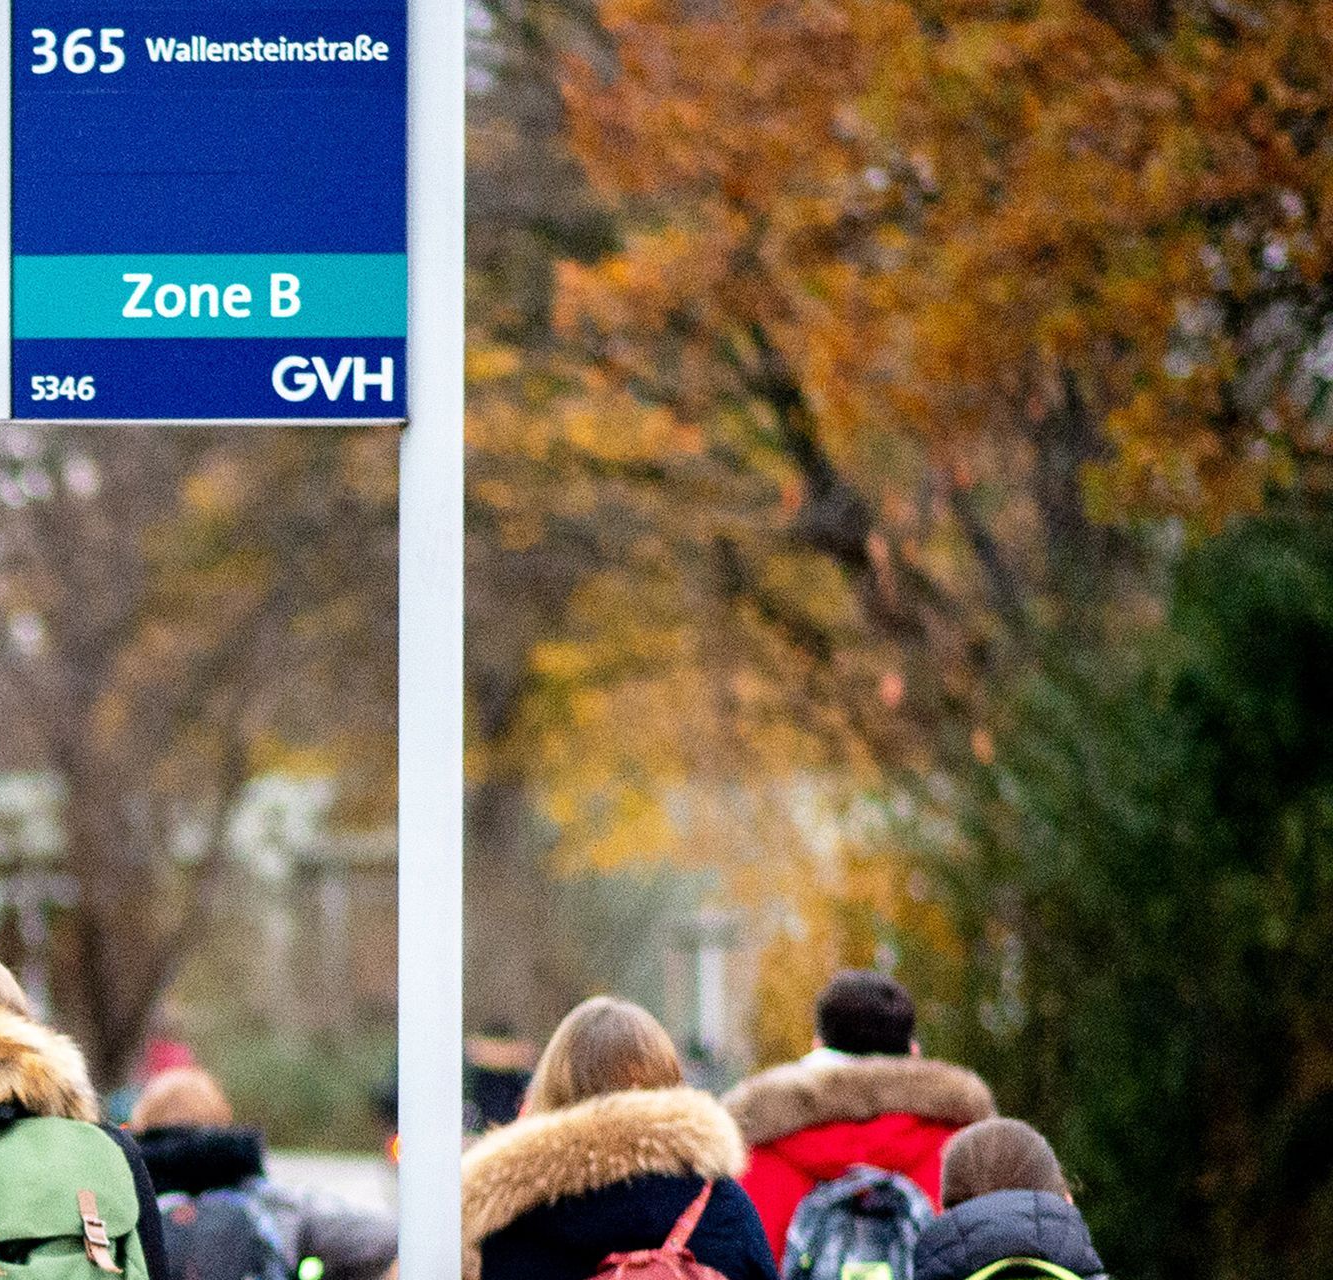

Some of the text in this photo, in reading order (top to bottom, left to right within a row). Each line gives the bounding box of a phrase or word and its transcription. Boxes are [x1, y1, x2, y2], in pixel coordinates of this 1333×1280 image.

[31, 28, 390, 75] 365 Wallensteinstraße
[122, 272, 302, 319] Zone B
[31, 375, 97, 401] 5346
[271, 355, 395, 402] GVH
